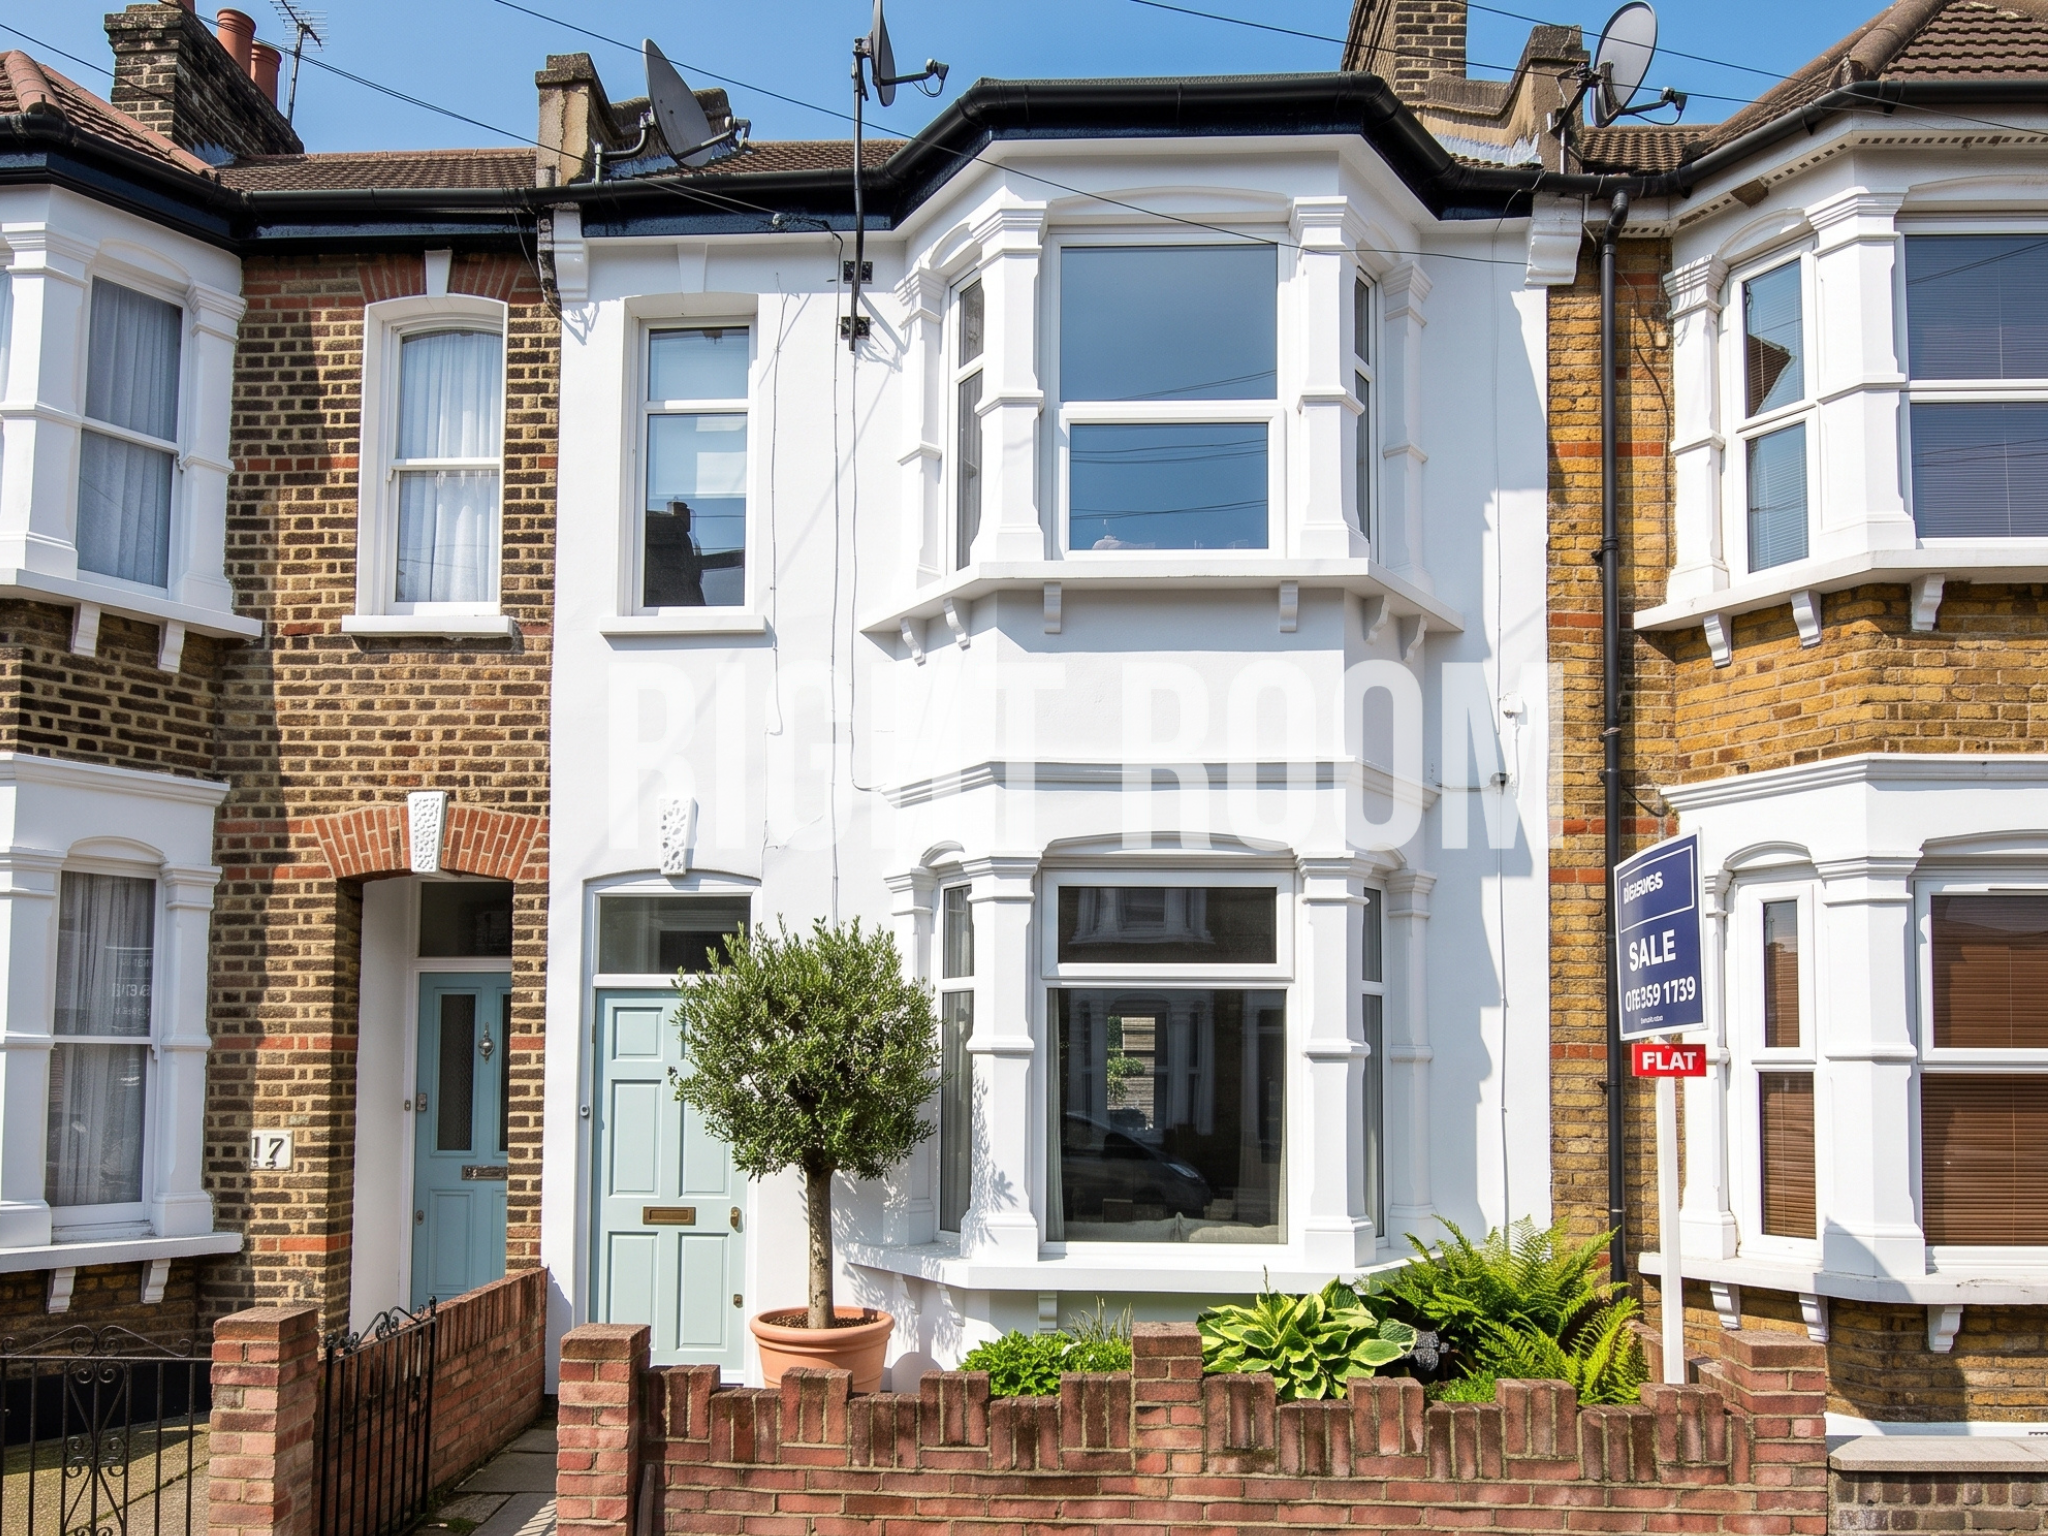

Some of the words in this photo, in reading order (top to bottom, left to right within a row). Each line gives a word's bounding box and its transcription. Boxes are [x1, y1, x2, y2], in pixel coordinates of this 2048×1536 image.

[1629, 929, 1676, 972] SALE
[1663, 976, 1695, 1004] 1739
[1642, 1051, 1697, 1070] FLAT
[251, 1136, 285, 1159] 17
